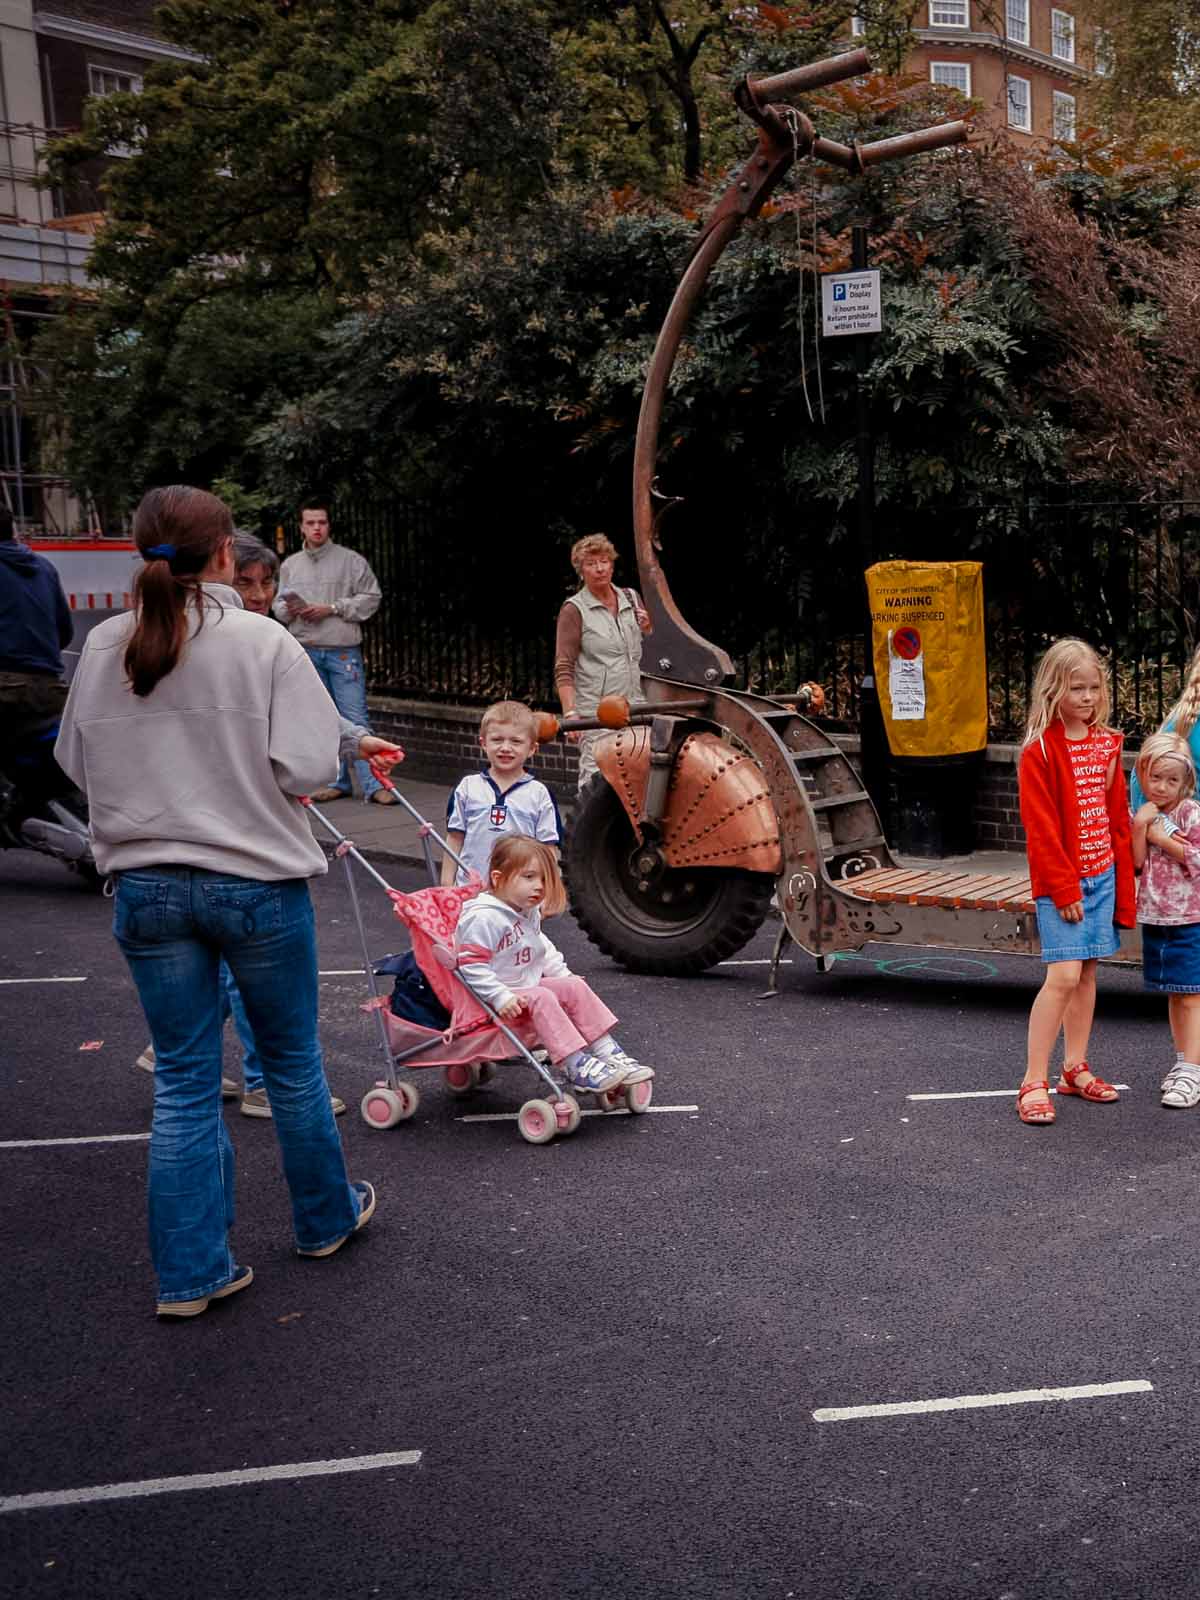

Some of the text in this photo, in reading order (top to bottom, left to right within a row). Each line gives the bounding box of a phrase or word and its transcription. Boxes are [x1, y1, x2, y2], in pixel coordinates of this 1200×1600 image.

[835, 285, 844, 300] P
[848, 312, 878, 321] prohibited
[834, 322, 852, 330] within
[884, 595, 933, 608] WARNING
[871, 611, 945, 623] ARKING SUSPENDED
[514, 946, 531, 966] 19
